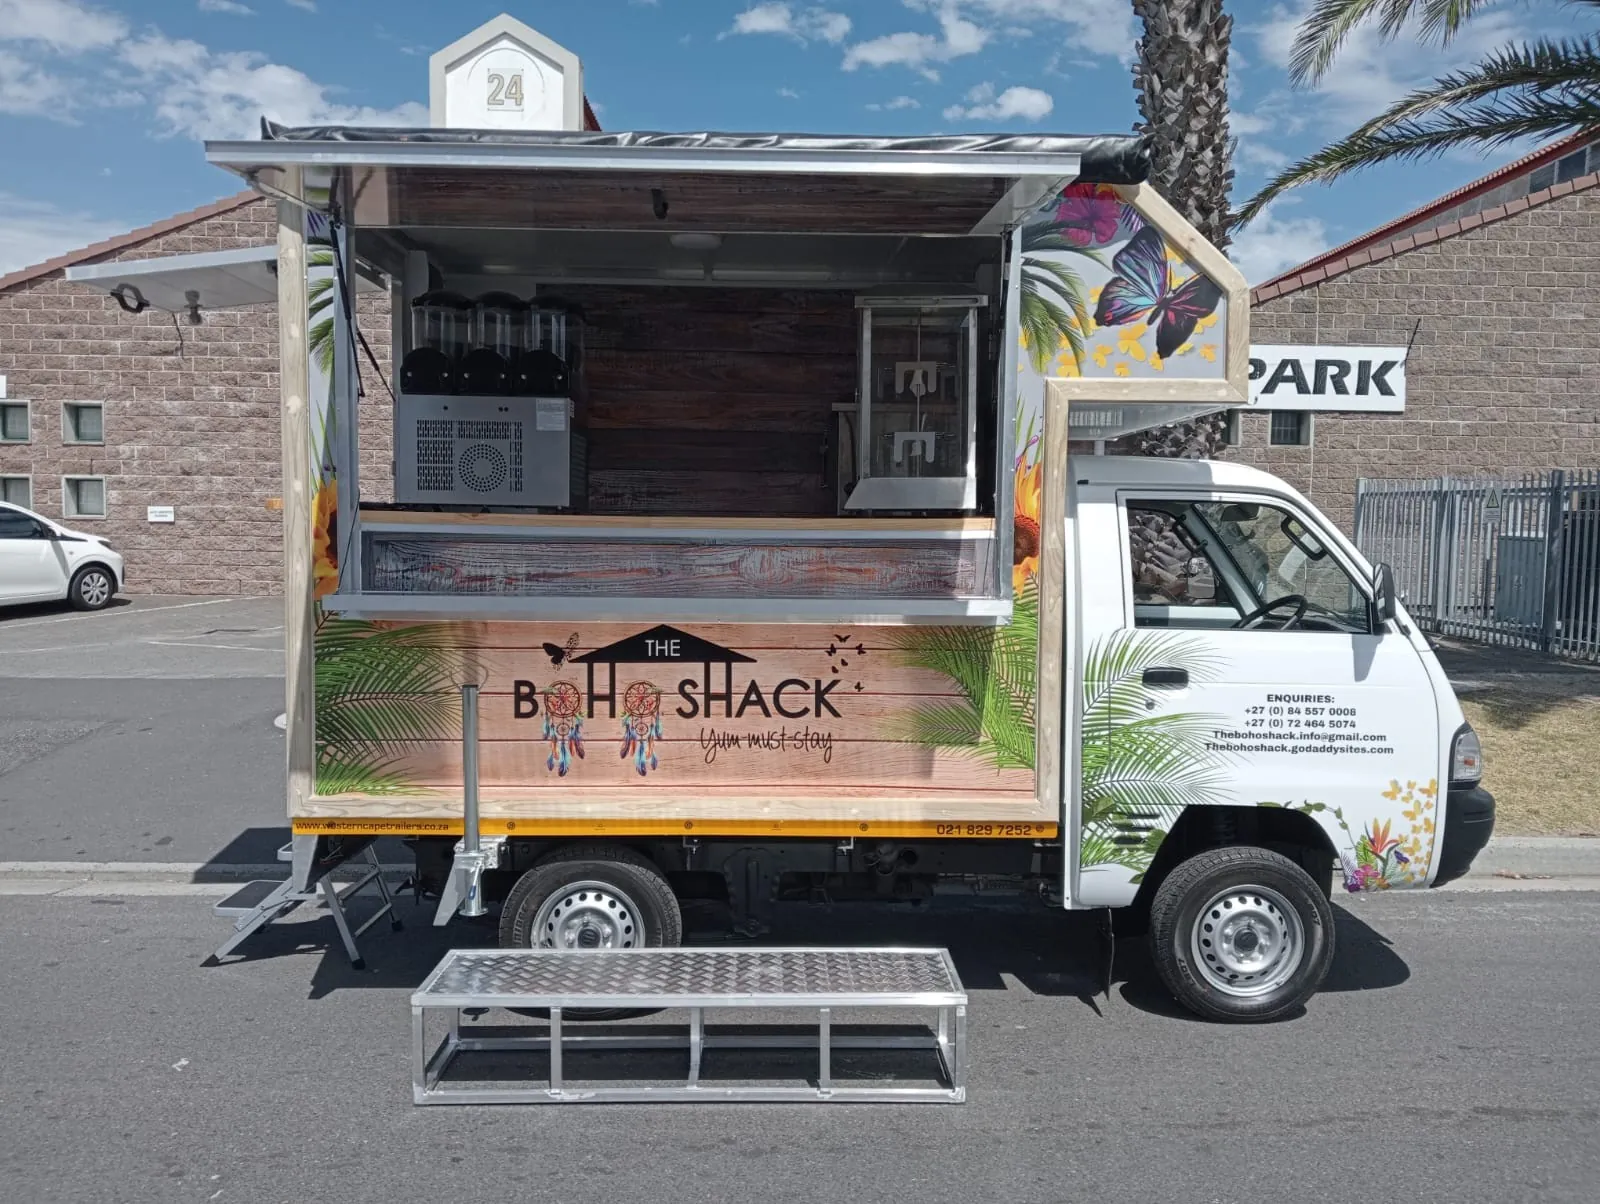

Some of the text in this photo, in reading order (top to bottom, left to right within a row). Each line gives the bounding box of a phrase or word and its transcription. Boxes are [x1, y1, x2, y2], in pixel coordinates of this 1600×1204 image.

[487, 73, 524, 106] 24
[645, 639, 681, 657] THE
[675, 661, 843, 719] SHACK
[1266, 693, 1336, 704] ENQUIRIES:
[1244, 706, 1357, 718] +27 (0) 84 557 0008
[1244, 718, 1357, 730] +27 (0) 72 464 5074
[1212, 730, 1388, 743] Thebohoshack.info@gmail.com
[1204, 742, 1395, 756] Thebohoshack.godaddysites.com
[295, 821, 450, 832] www.westerncapetrailers.co.za
[936, 824, 1032, 836] 021 829 7252
